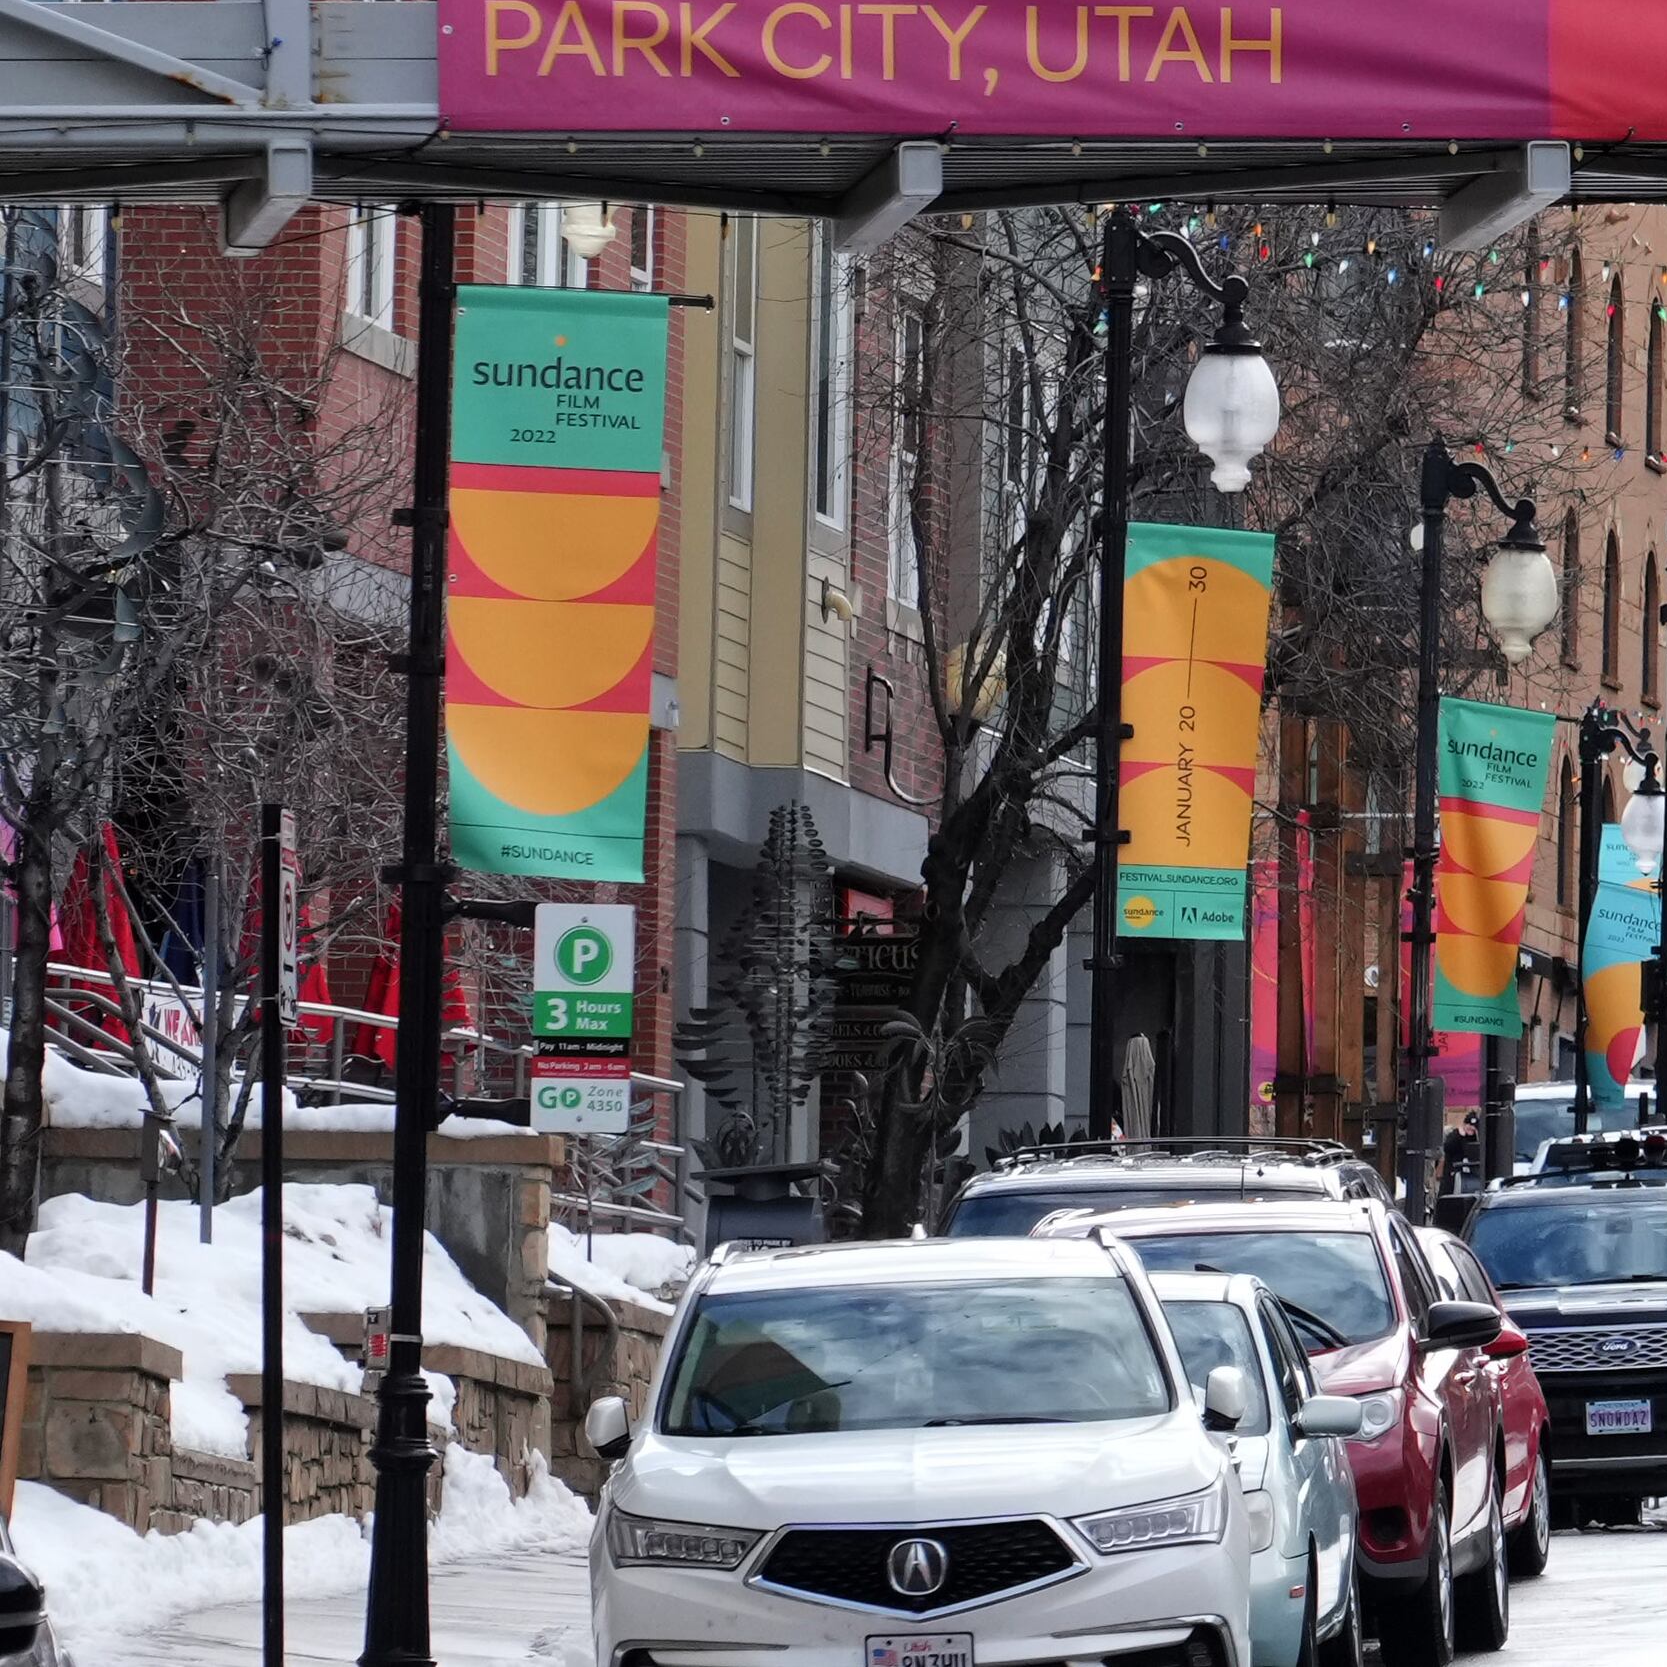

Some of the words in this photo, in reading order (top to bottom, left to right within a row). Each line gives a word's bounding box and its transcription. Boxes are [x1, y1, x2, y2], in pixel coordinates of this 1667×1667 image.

[484, 0, 738, 79] PARK
[761, 2, 998, 96] CITY,
[1025, 5, 1283, 85] UTAH
[473, 357, 644, 392] sundance
[556, 395, 599, 409] FILM
[556, 413, 641, 430] FESTIVAL
[510, 429, 556, 444] 2022
[1188, 565, 1208, 593] 30
[1178, 705, 1196, 732] 20
[1447, 738, 1538, 768] sundance
[1486, 762, 1512, 774] FILM
[1461, 778, 1485, 791] 2022
[1485, 772, 1532, 789] FESTIVAL
[1174, 743, 1195, 848] JANUARY
[501, 845, 595, 866] #SUNDANCE
[1120, 871, 1239, 886] FESTIVAL.SUNDANCE.ORG
[1123, 908, 1165, 917] sundance
[1201, 911, 1234, 923] Adobe
[573, 938, 600, 974] P
[848, 944, 920, 971] TICUS
[545, 998, 568, 1031] 3
[576, 1000, 622, 1014] Hours
[1454, 1014, 1505, 1027] #SUNDANCE
[575, 1017, 609, 1031] Max
[540, 1042, 555, 1053] Pay
[587, 1086, 623, 1097] Zone
[587, 1100, 623, 1112] 4350
[1603, 1342, 1629, 1351] Ford
